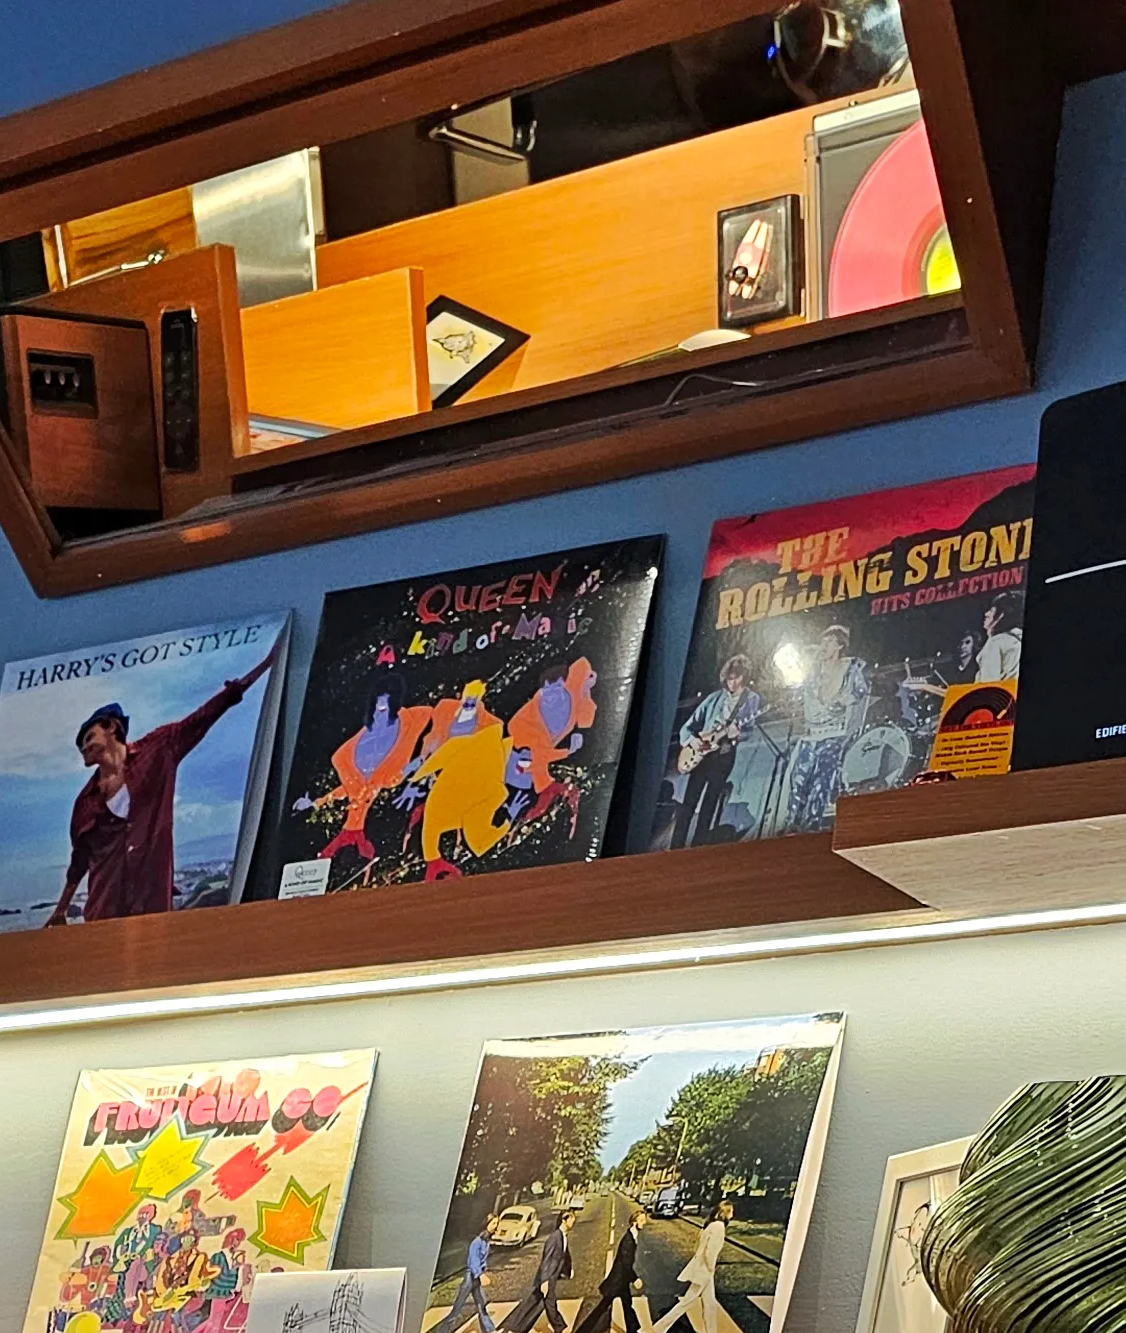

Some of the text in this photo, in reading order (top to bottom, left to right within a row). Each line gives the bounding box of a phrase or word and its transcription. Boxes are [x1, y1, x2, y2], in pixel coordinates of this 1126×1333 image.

[716, 517, 1034, 630] ROLLING STON
[776, 527, 850, 575] THE
[416, 564, 566, 625] QUEEN
[870, 566, 1025, 617] HITS COLLECTION
[17, 624, 263, 691] HARRY'S GOT STYLE
[376, 643, 396, 665] A
[511, 609, 594, 640] Maic
[1095, 723, 1126, 739] EDIFIE
